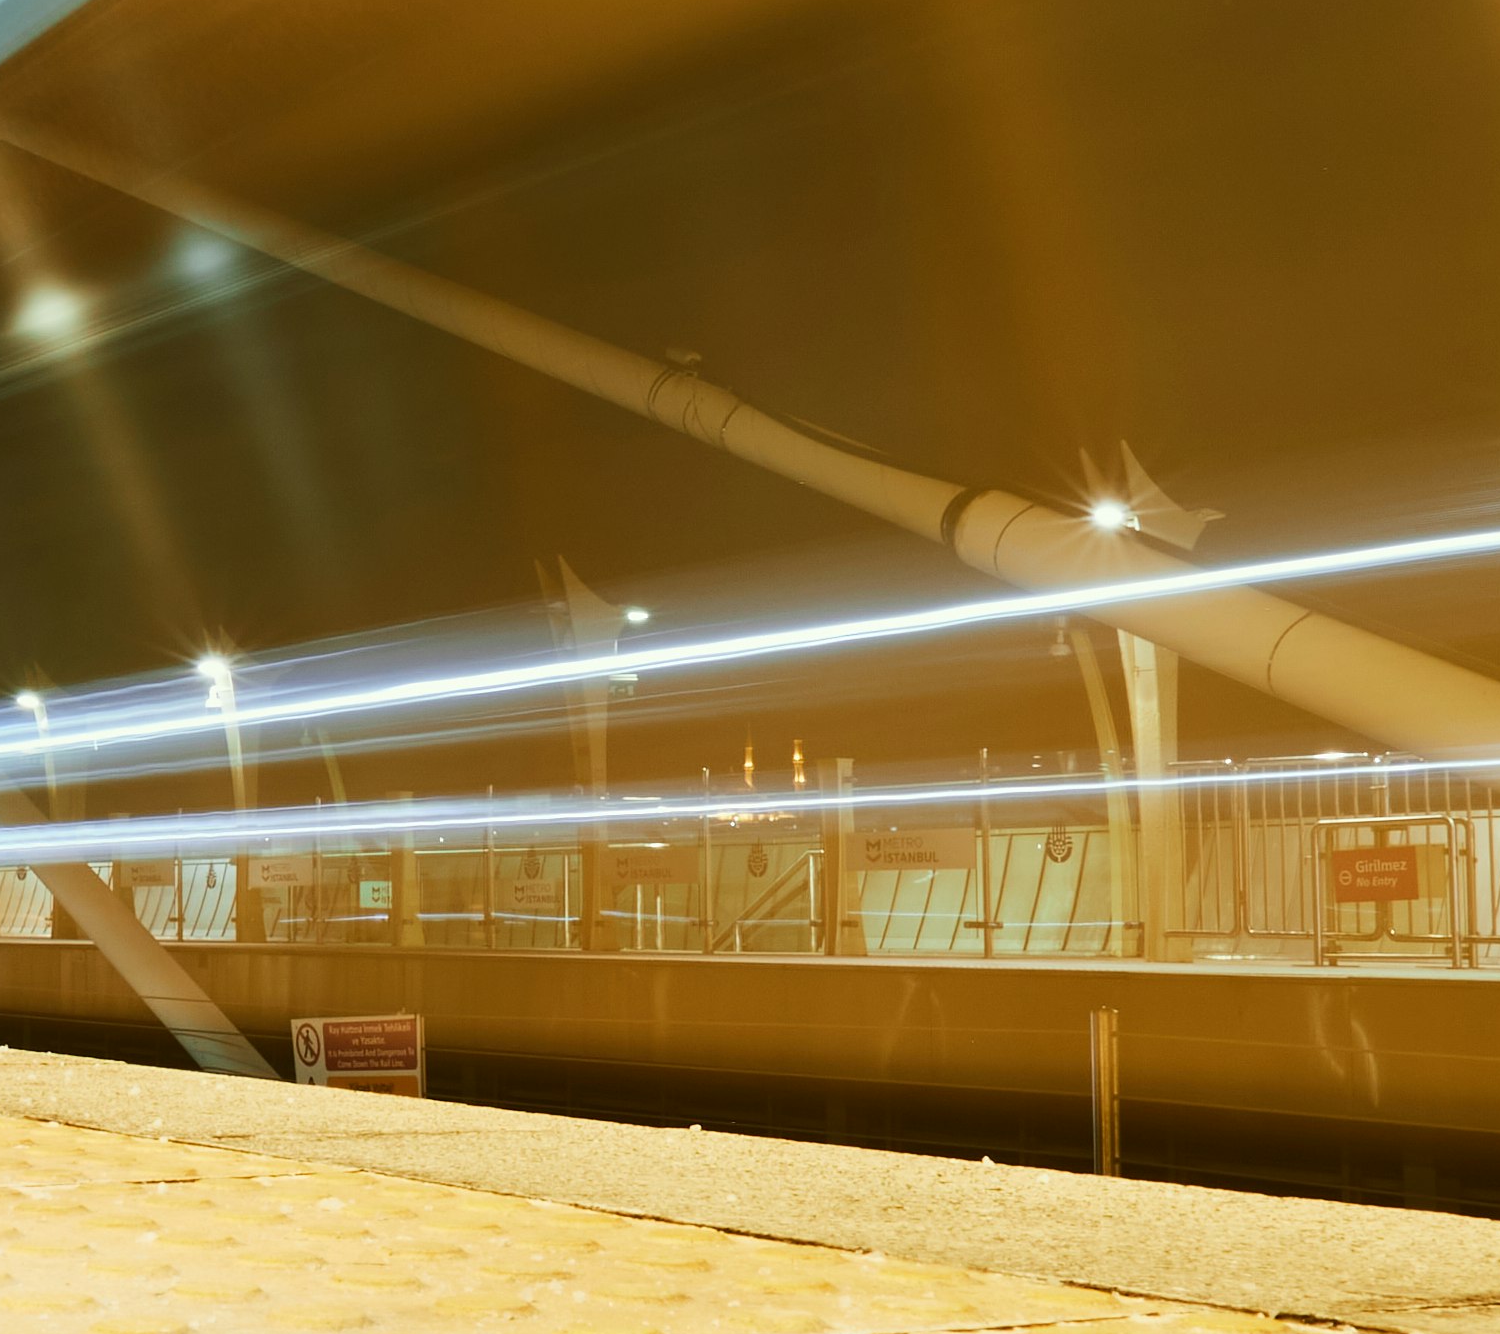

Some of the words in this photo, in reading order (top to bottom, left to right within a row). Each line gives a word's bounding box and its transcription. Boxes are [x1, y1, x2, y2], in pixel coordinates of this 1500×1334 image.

[882, 836, 924, 848] METRO
[884, 850, 939, 864] İSTANBUL
[1355, 859, 1408, 873] Girilmez
[1356, 877, 1370, 887] No
[1372, 876, 1398, 887] Entry
